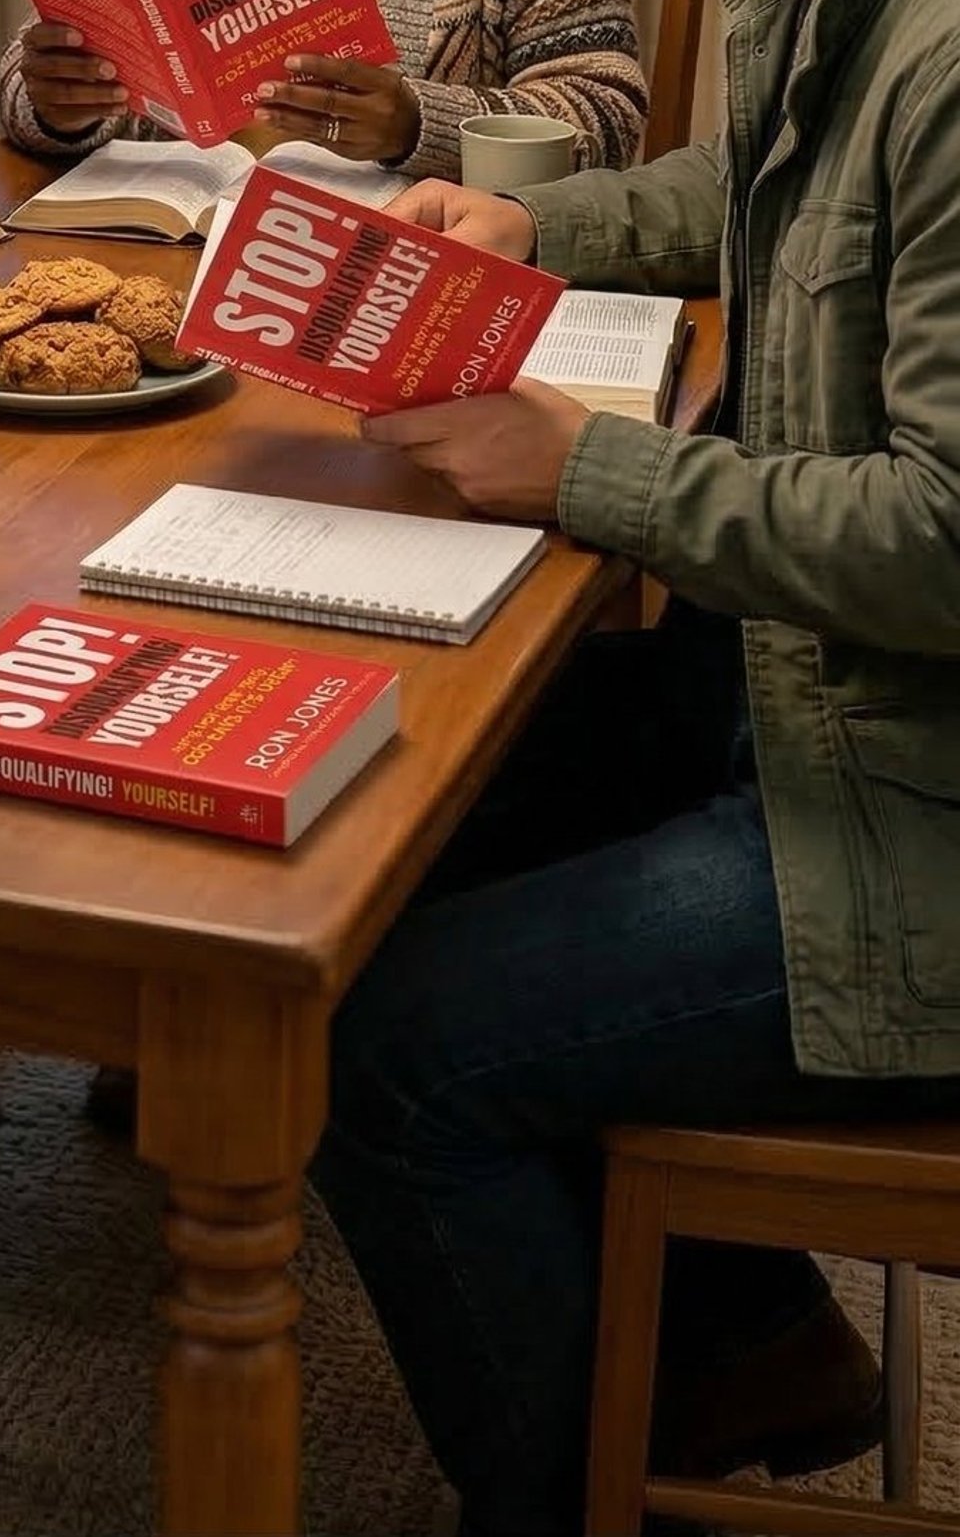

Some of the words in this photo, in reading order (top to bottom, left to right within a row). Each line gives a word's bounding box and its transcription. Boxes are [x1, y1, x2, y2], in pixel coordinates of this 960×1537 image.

[213, 189, 359, 348] STOP!
[328, 237, 441, 375] YOURSELF!
[451, 353, 488, 398] RON
[478, 295, 522, 354] JONES
[86, 645, 241, 749] YOURSELF!
[245, 729, 300, 769] RON
[286, 676, 348, 729] JONES
[122, 783, 216, 818] YOURSELF!
